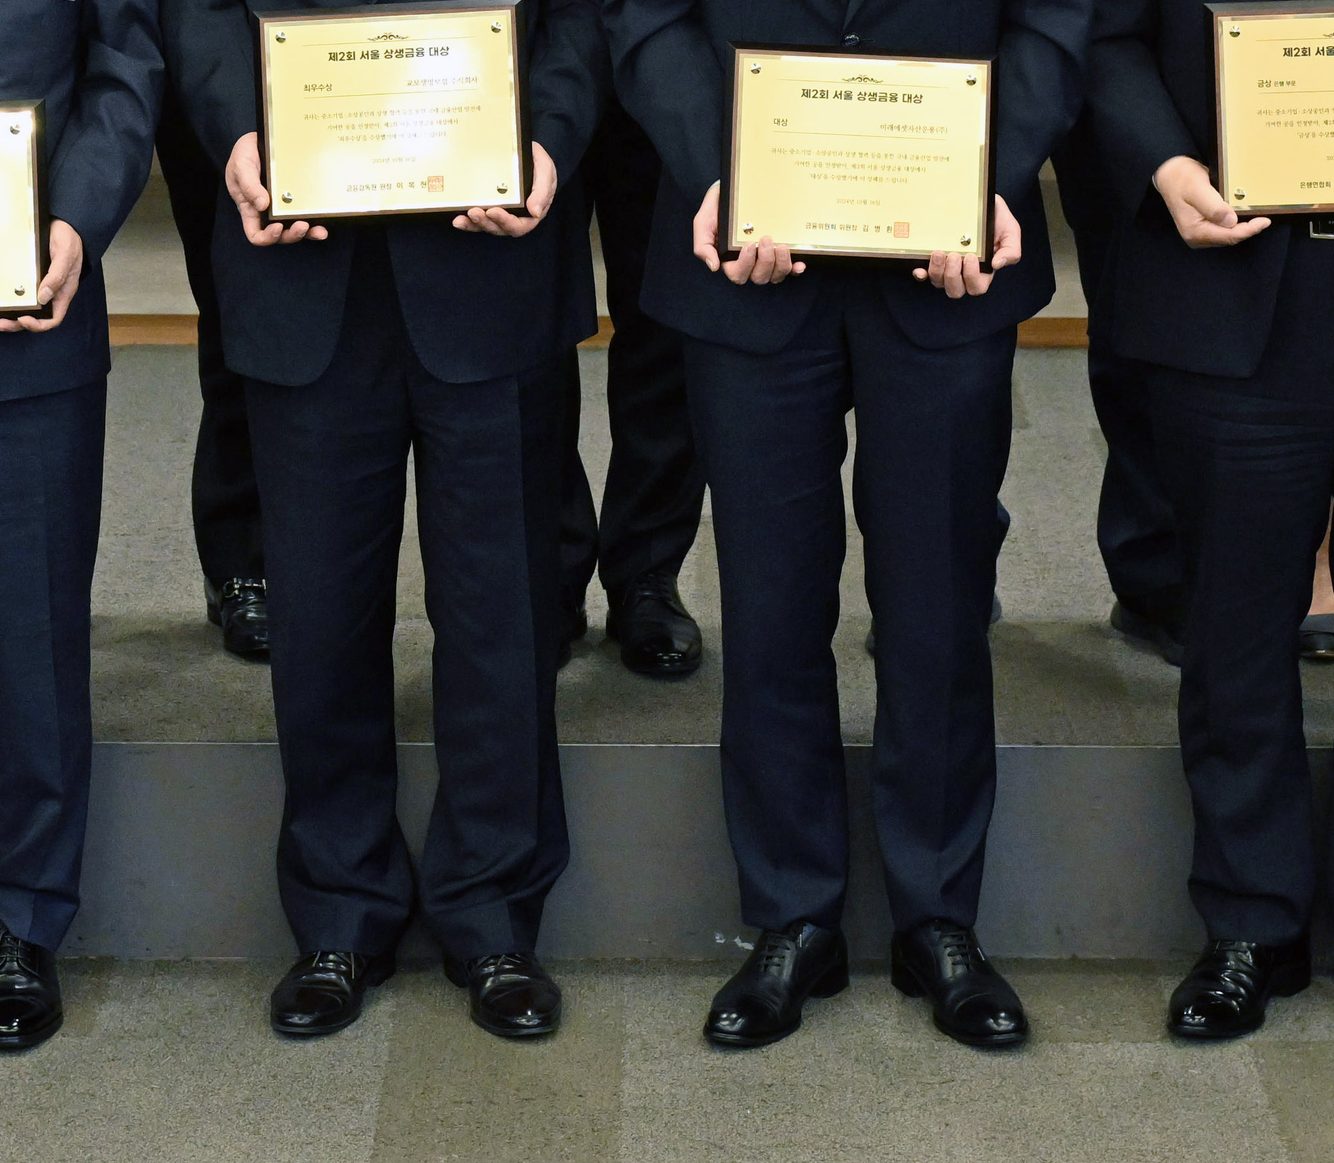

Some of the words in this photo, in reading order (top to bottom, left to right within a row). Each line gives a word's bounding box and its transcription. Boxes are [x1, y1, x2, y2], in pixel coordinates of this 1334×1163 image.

[328, 51, 356, 62] 제2회
[360, 49, 380, 60] 서울
[384, 47, 425, 59] 상생금융
[429, 46, 449, 57] 대상
[1283, 47, 1311, 57] 제2회
[1315, 46, 1334, 56] 서울
[304, 83, 333, 92] 최우수상
[801, 89, 829, 99] 제2회
[833, 90, 853, 101] 서울
[857, 91, 898, 103] 상생금융
[902, 94, 922, 104] 대상
[774, 118, 788, 126] 대상
[380, 182, 392, 190] 원장
